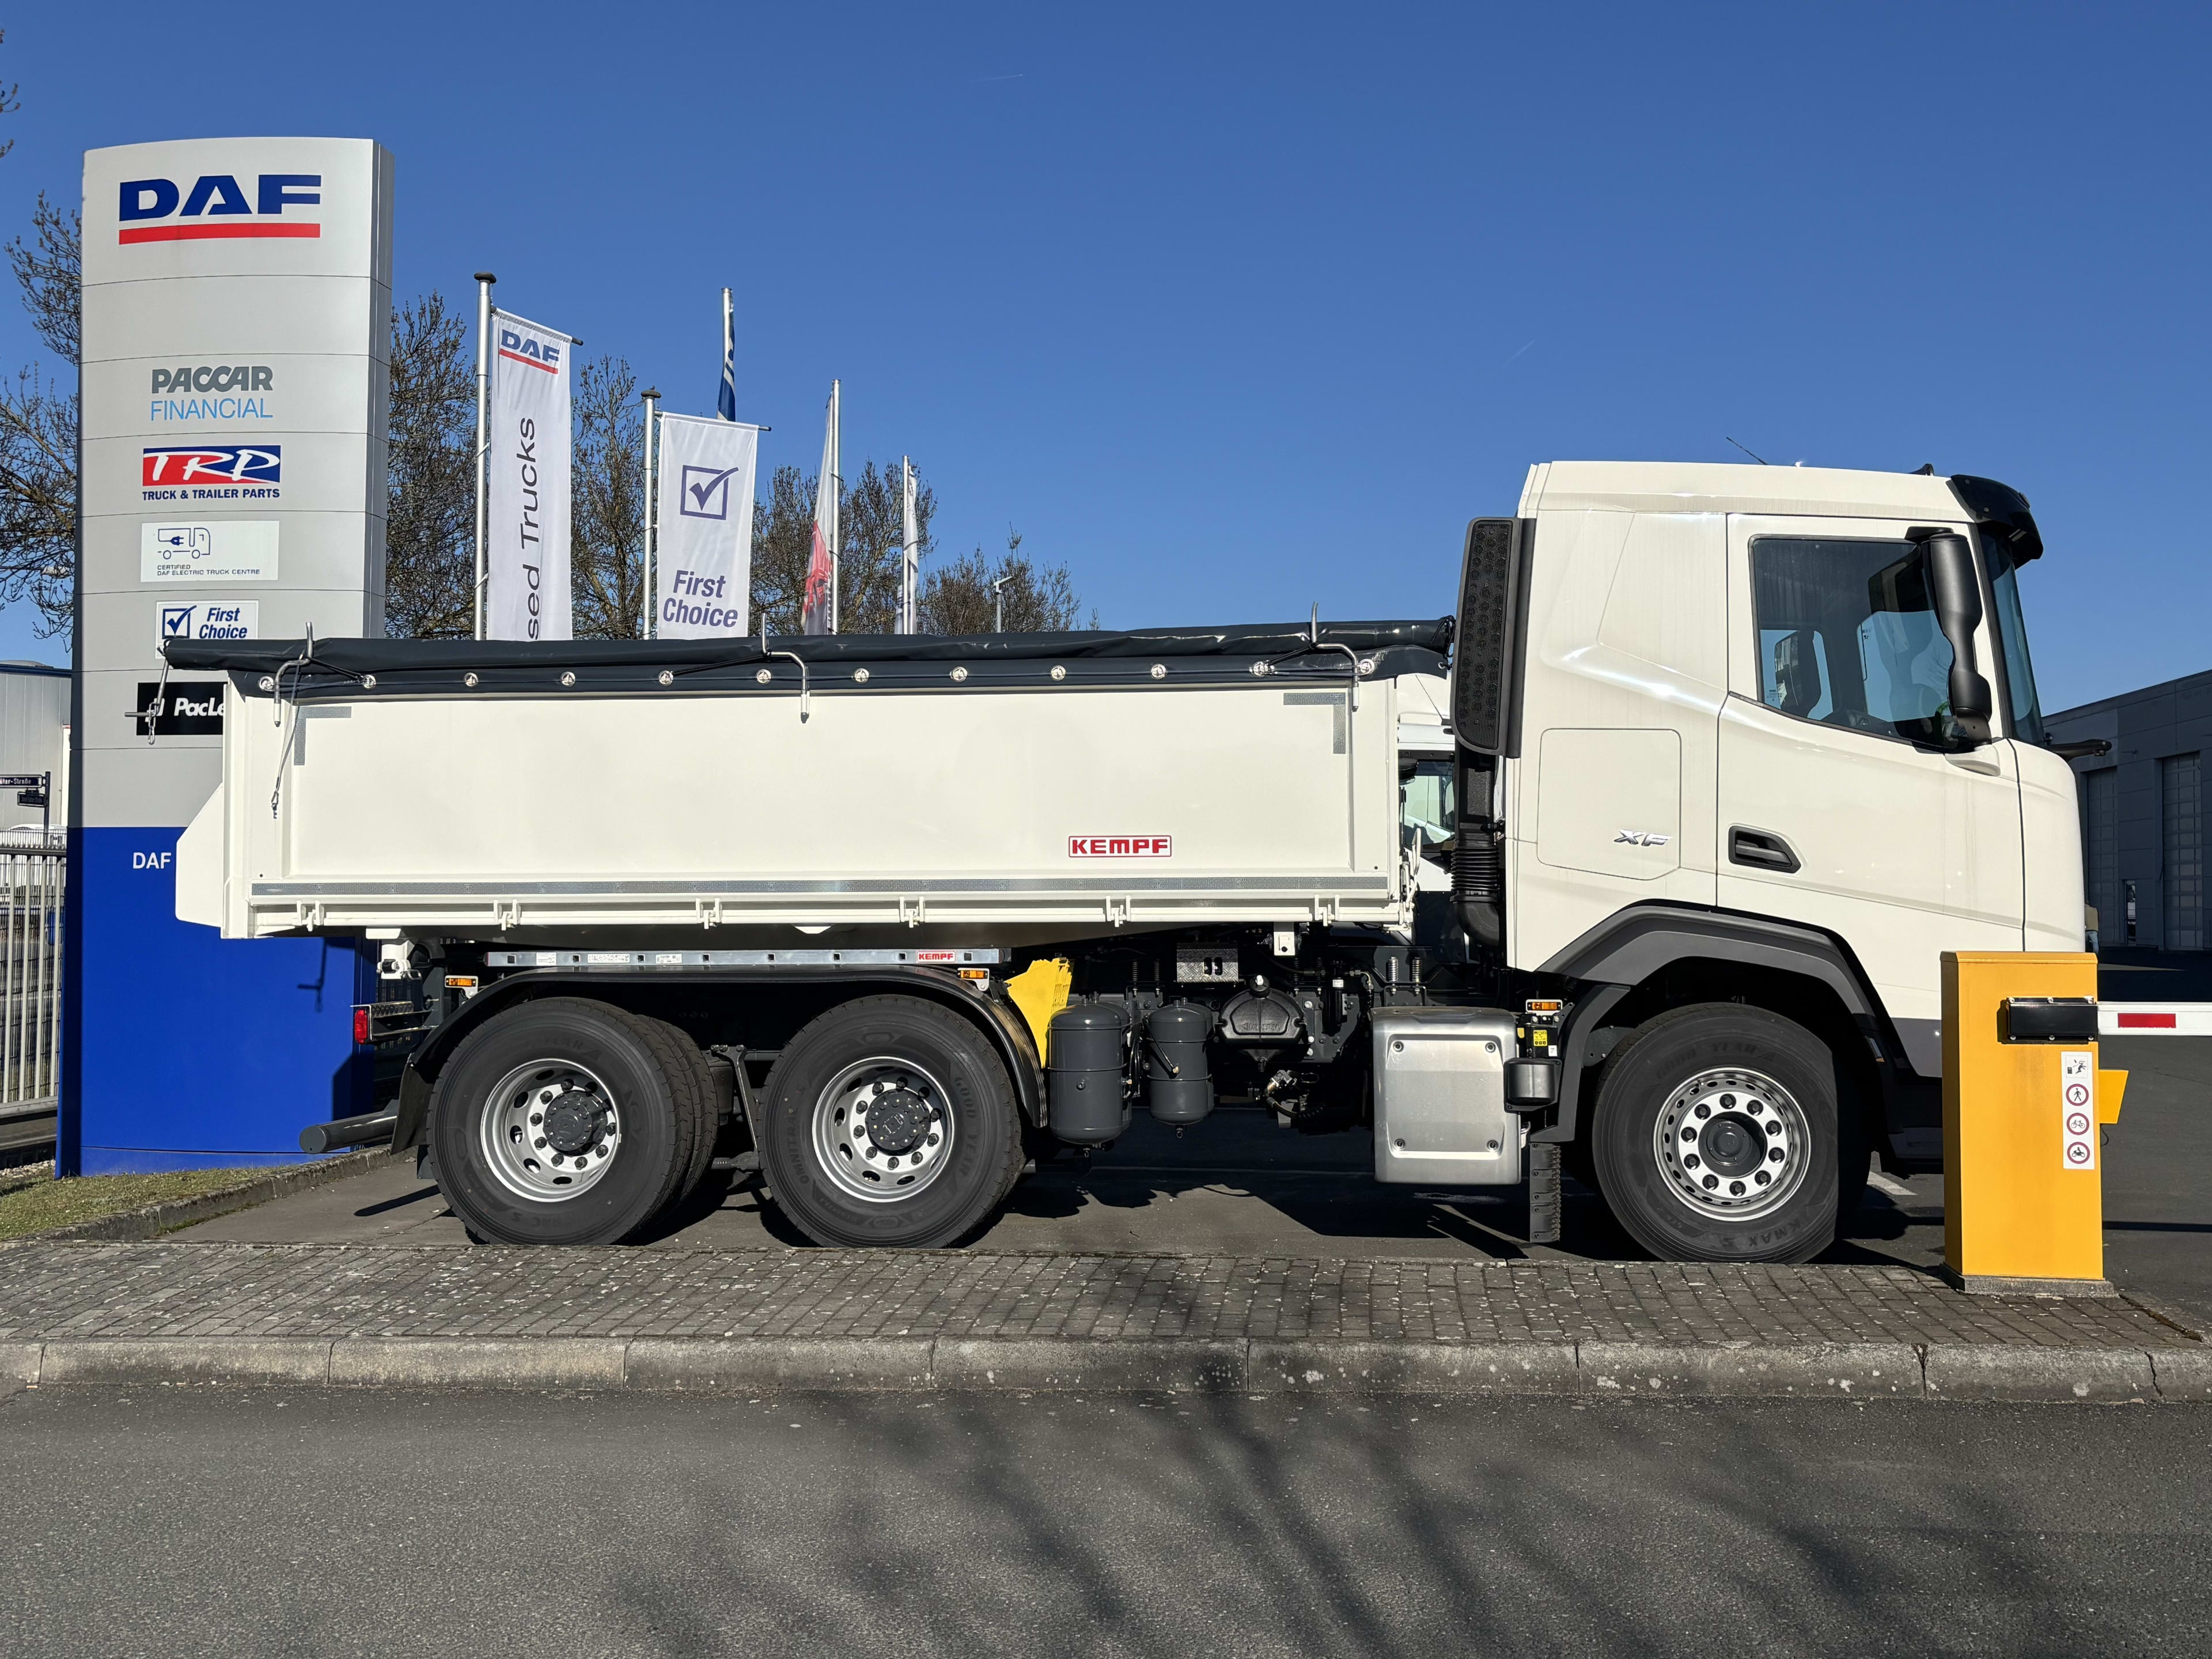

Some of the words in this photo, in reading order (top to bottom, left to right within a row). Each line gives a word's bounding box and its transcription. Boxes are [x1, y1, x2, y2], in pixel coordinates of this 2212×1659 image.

[119, 175, 321, 221] DAF
[501, 329, 560, 362] DAF
[151, 366, 273, 394] PACCAR
[151, 398, 273, 421] FINANCIAL
[143, 449, 281, 483] TRP
[142, 490, 176, 501] TRUCK
[180, 490, 189, 499] &
[192, 488, 239, 499] TRAILER
[243, 488, 280, 498] PARTS
[517, 418, 539, 550] Trucks
[673, 570, 726, 599] First
[207, 607, 240, 622] First
[663, 597, 738, 628] Choice
[199, 624, 248, 639] Choice
[1072, 839, 1168, 854] KEMPF
[1613, 829, 1673, 847] XF
[132, 852, 172, 869] DAF
